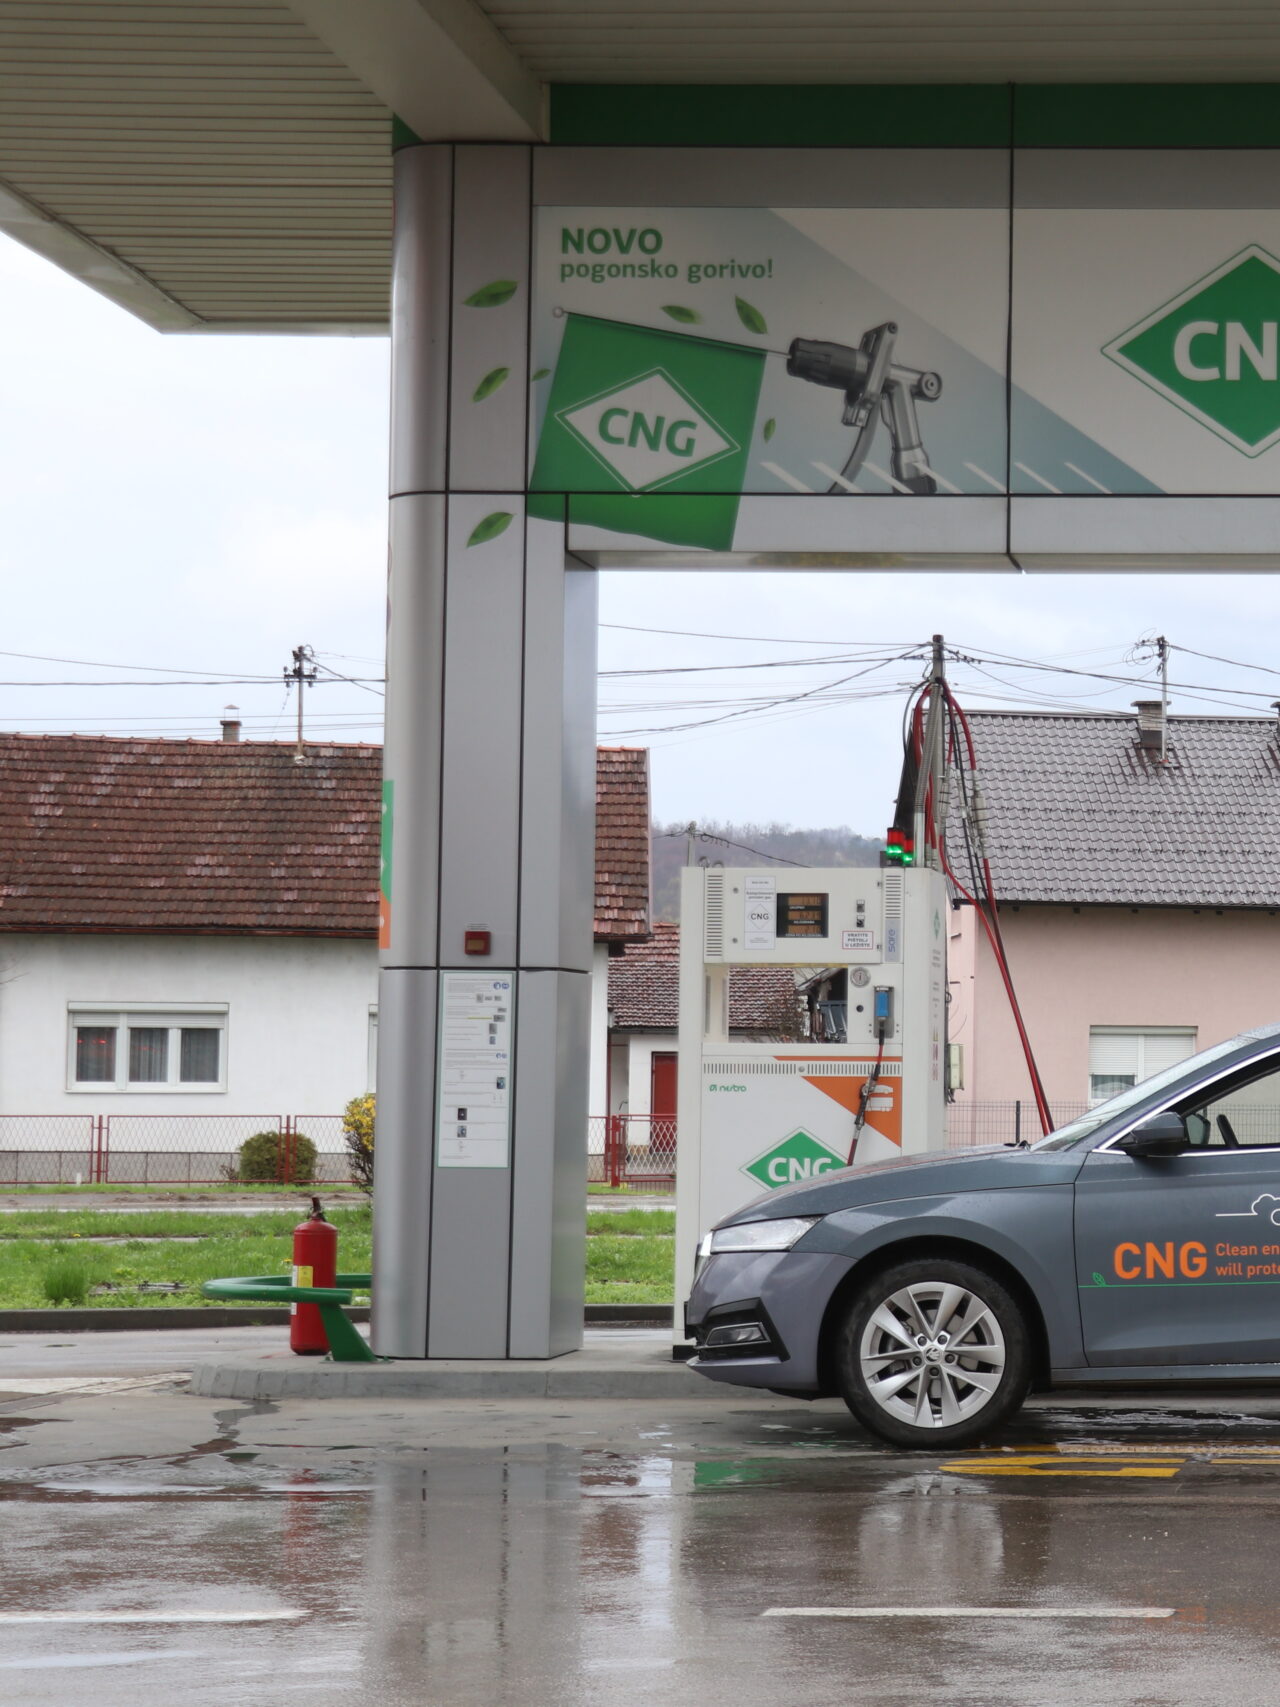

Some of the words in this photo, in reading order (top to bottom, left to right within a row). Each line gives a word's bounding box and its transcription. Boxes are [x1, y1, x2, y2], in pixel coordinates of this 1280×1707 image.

[561, 227, 663, 255] NOVO
[560, 258, 679, 284] pogonsko
[687, 257, 774, 284] gorivo!
[598, 406, 701, 459] CNG
[750, 912, 770, 922] CNG
[767, 1157, 833, 1183] CNG
[1113, 1241, 1209, 1280] CNG
[1215, 1243, 1258, 1257] Clean
[1215, 1262, 1243, 1277] will
